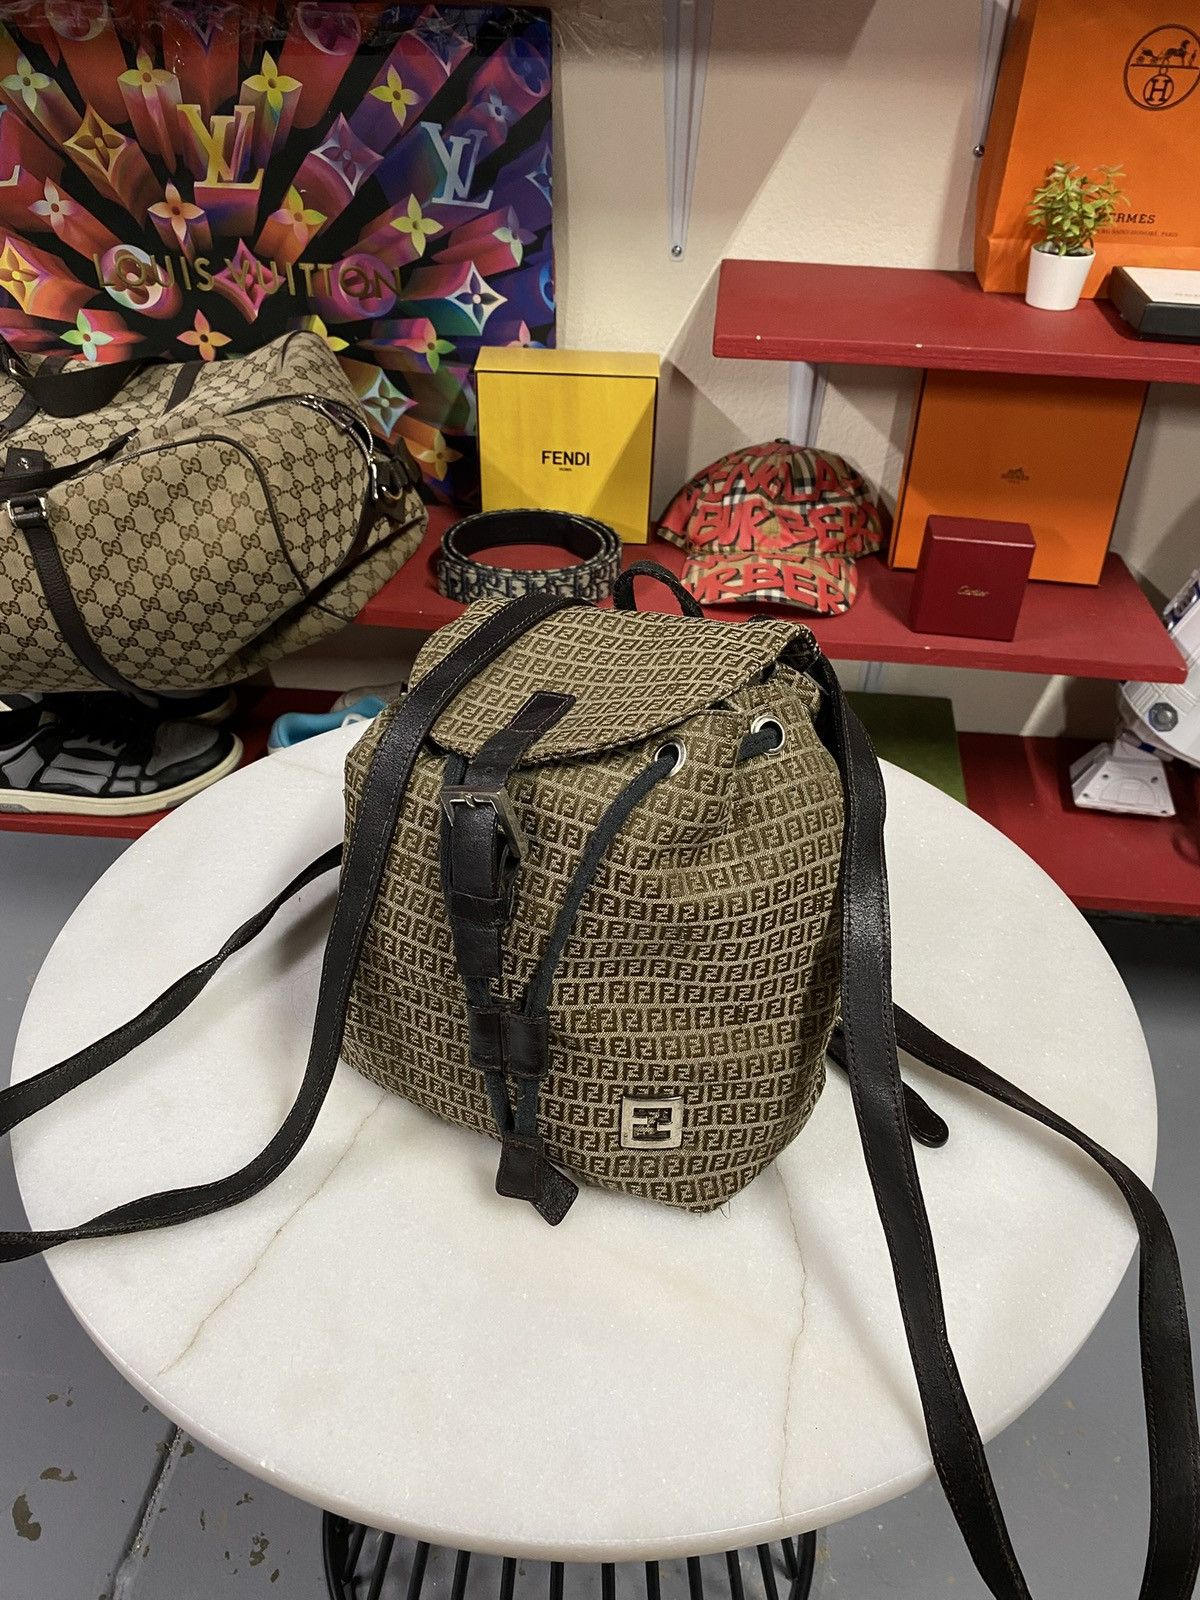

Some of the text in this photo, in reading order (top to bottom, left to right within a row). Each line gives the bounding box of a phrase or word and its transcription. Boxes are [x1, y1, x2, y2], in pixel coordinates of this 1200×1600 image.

[1097, 210, 1156, 224] RMES
[93, 253, 402, 299] LOUIS VUITTON
[542, 450, 590, 466] FENDI
